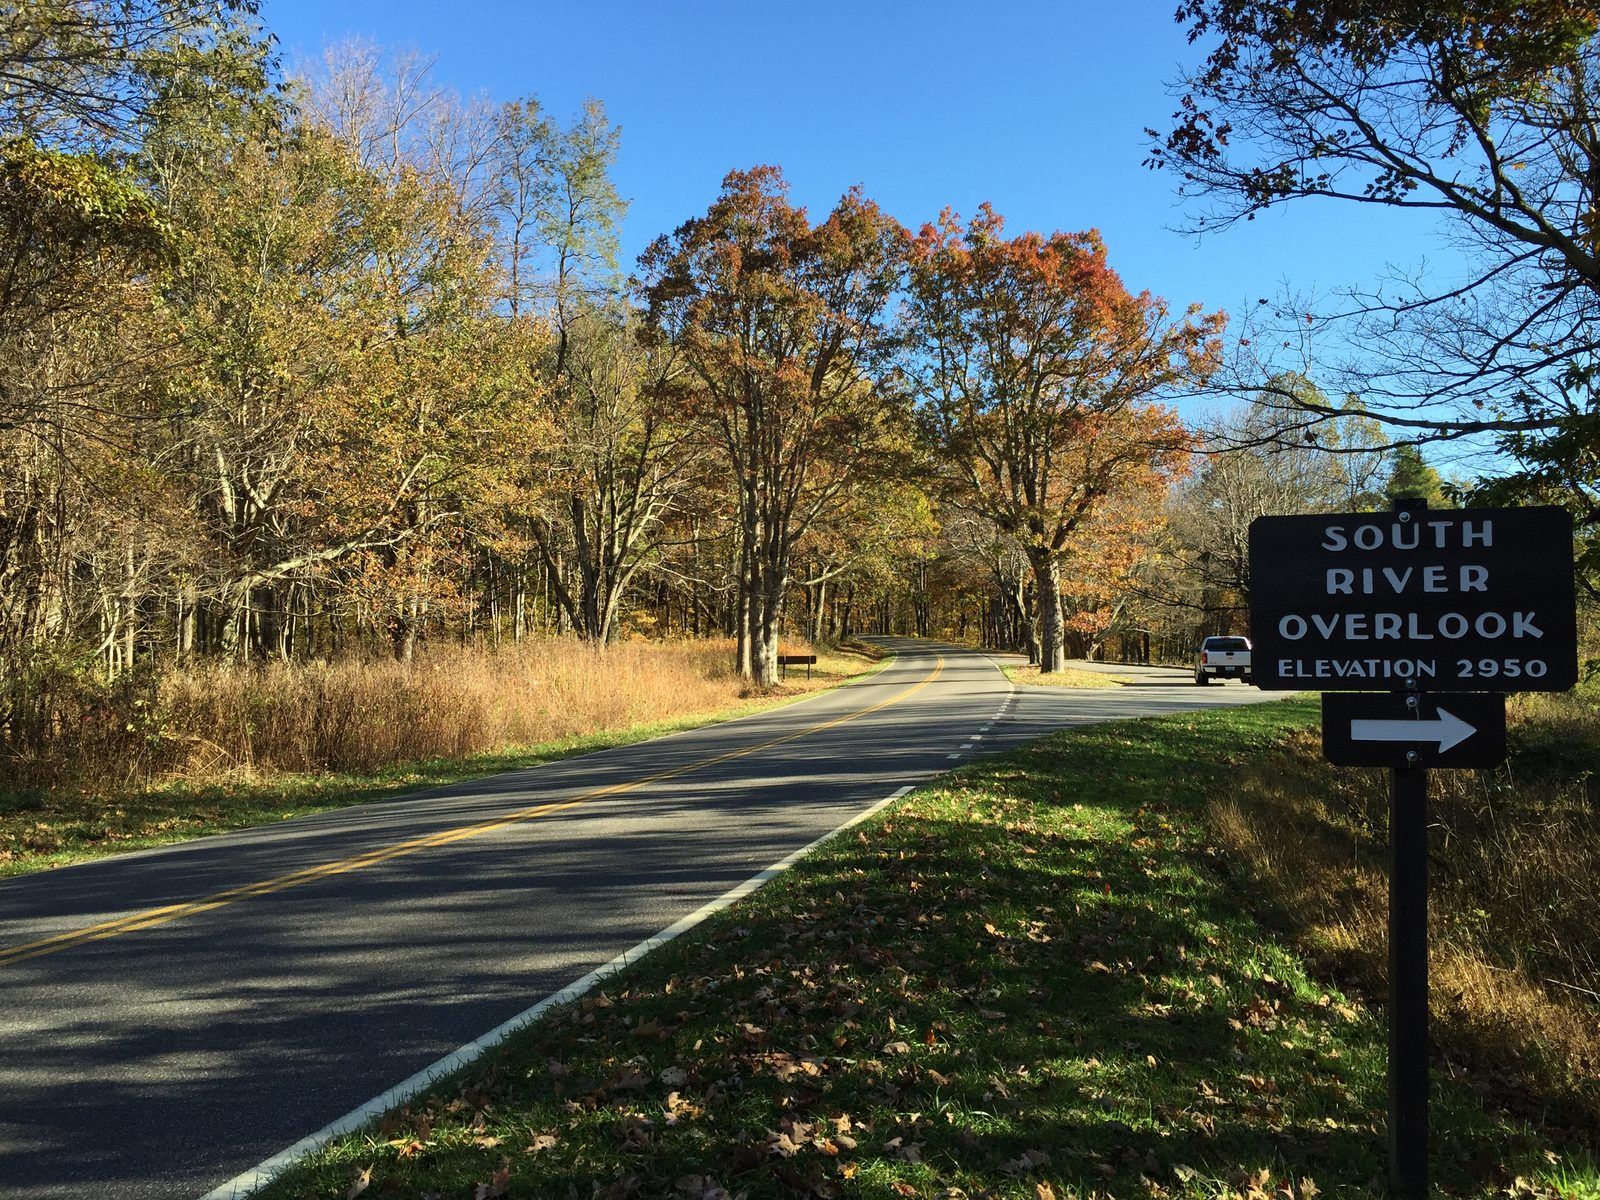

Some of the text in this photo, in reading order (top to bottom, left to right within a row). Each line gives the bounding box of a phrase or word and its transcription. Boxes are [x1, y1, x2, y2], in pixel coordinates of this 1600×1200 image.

[1321, 520, 1493, 551] SOUTH
[1326, 565, 1489, 594] RIVER
[1278, 611, 1544, 640] OVERLOOK
[1278, 659, 1548, 678] ELEVATION 2950
